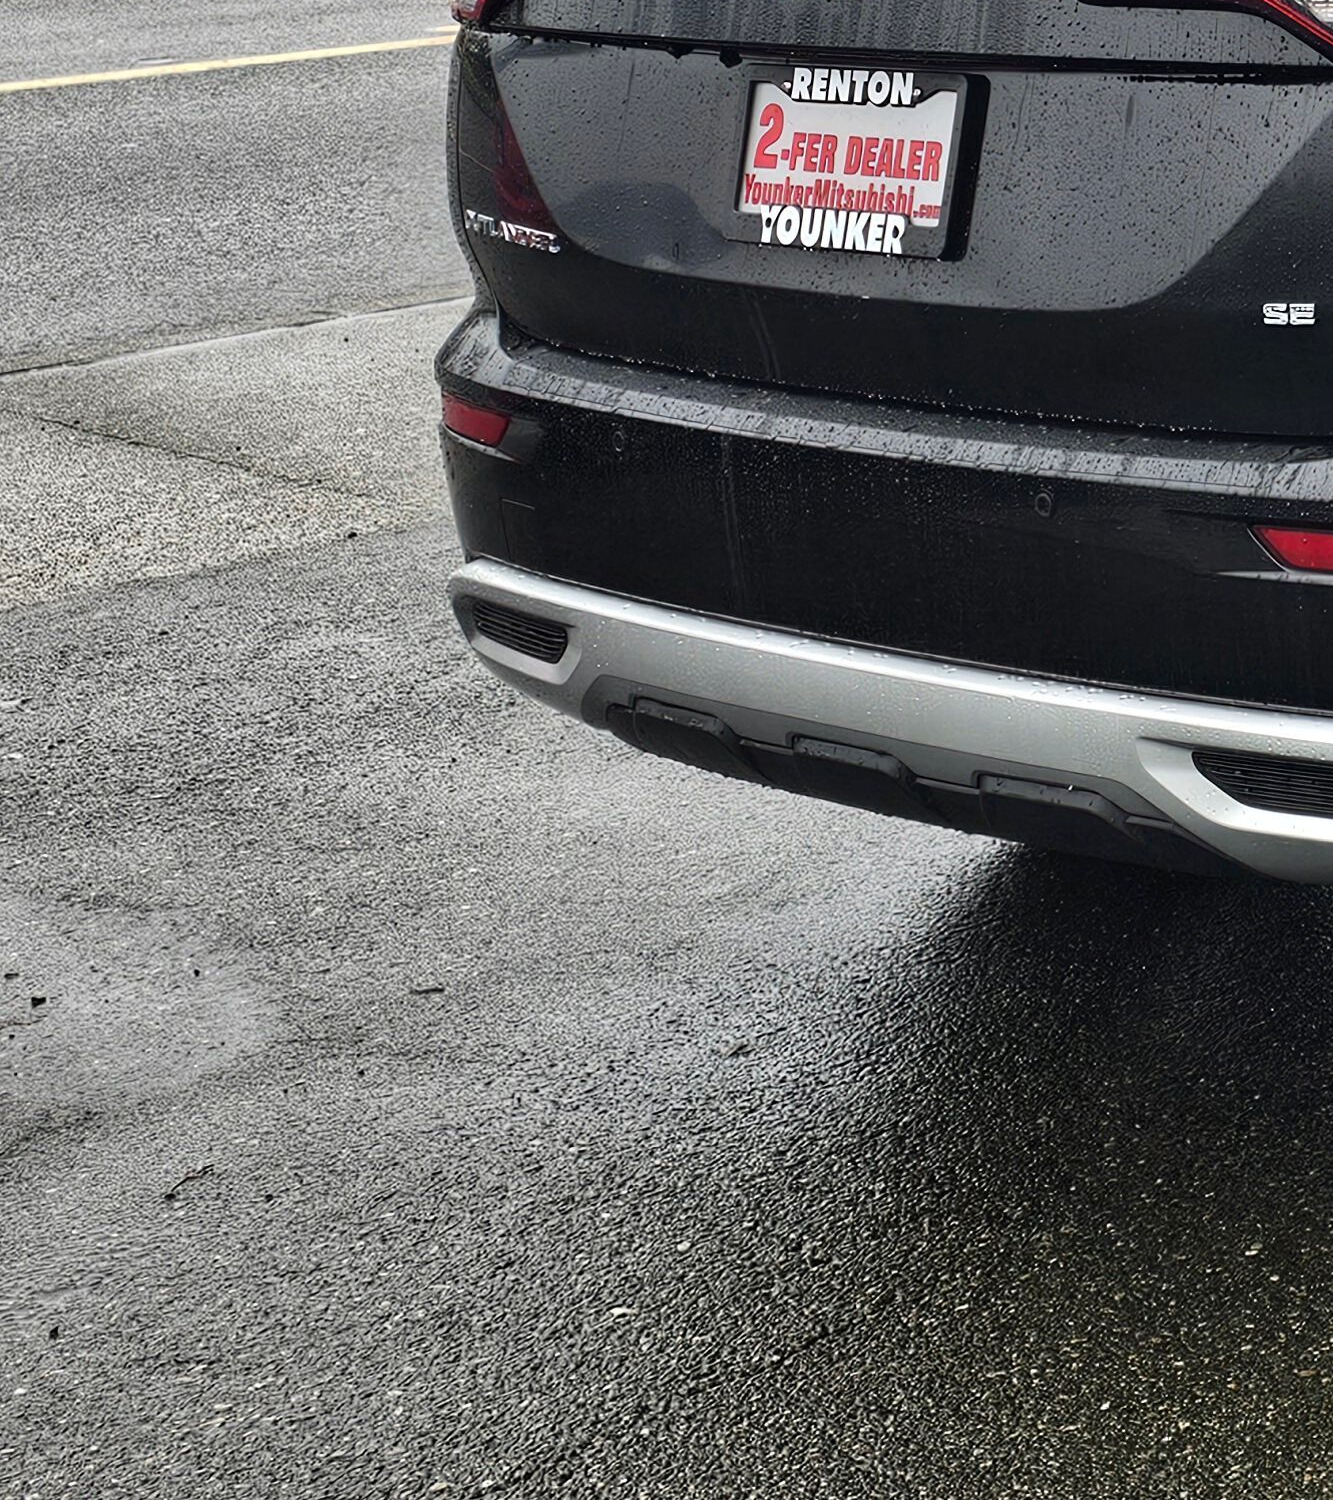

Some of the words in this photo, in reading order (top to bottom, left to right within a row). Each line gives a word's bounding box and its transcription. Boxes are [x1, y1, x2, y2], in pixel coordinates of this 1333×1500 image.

[790, 67, 914, 106] RENTON
[753, 102, 838, 174] 2-FER
[843, 135, 943, 182] DEALER
[760, 204, 906, 254] YOUNKER
[1262, 303, 1316, 326] SE
